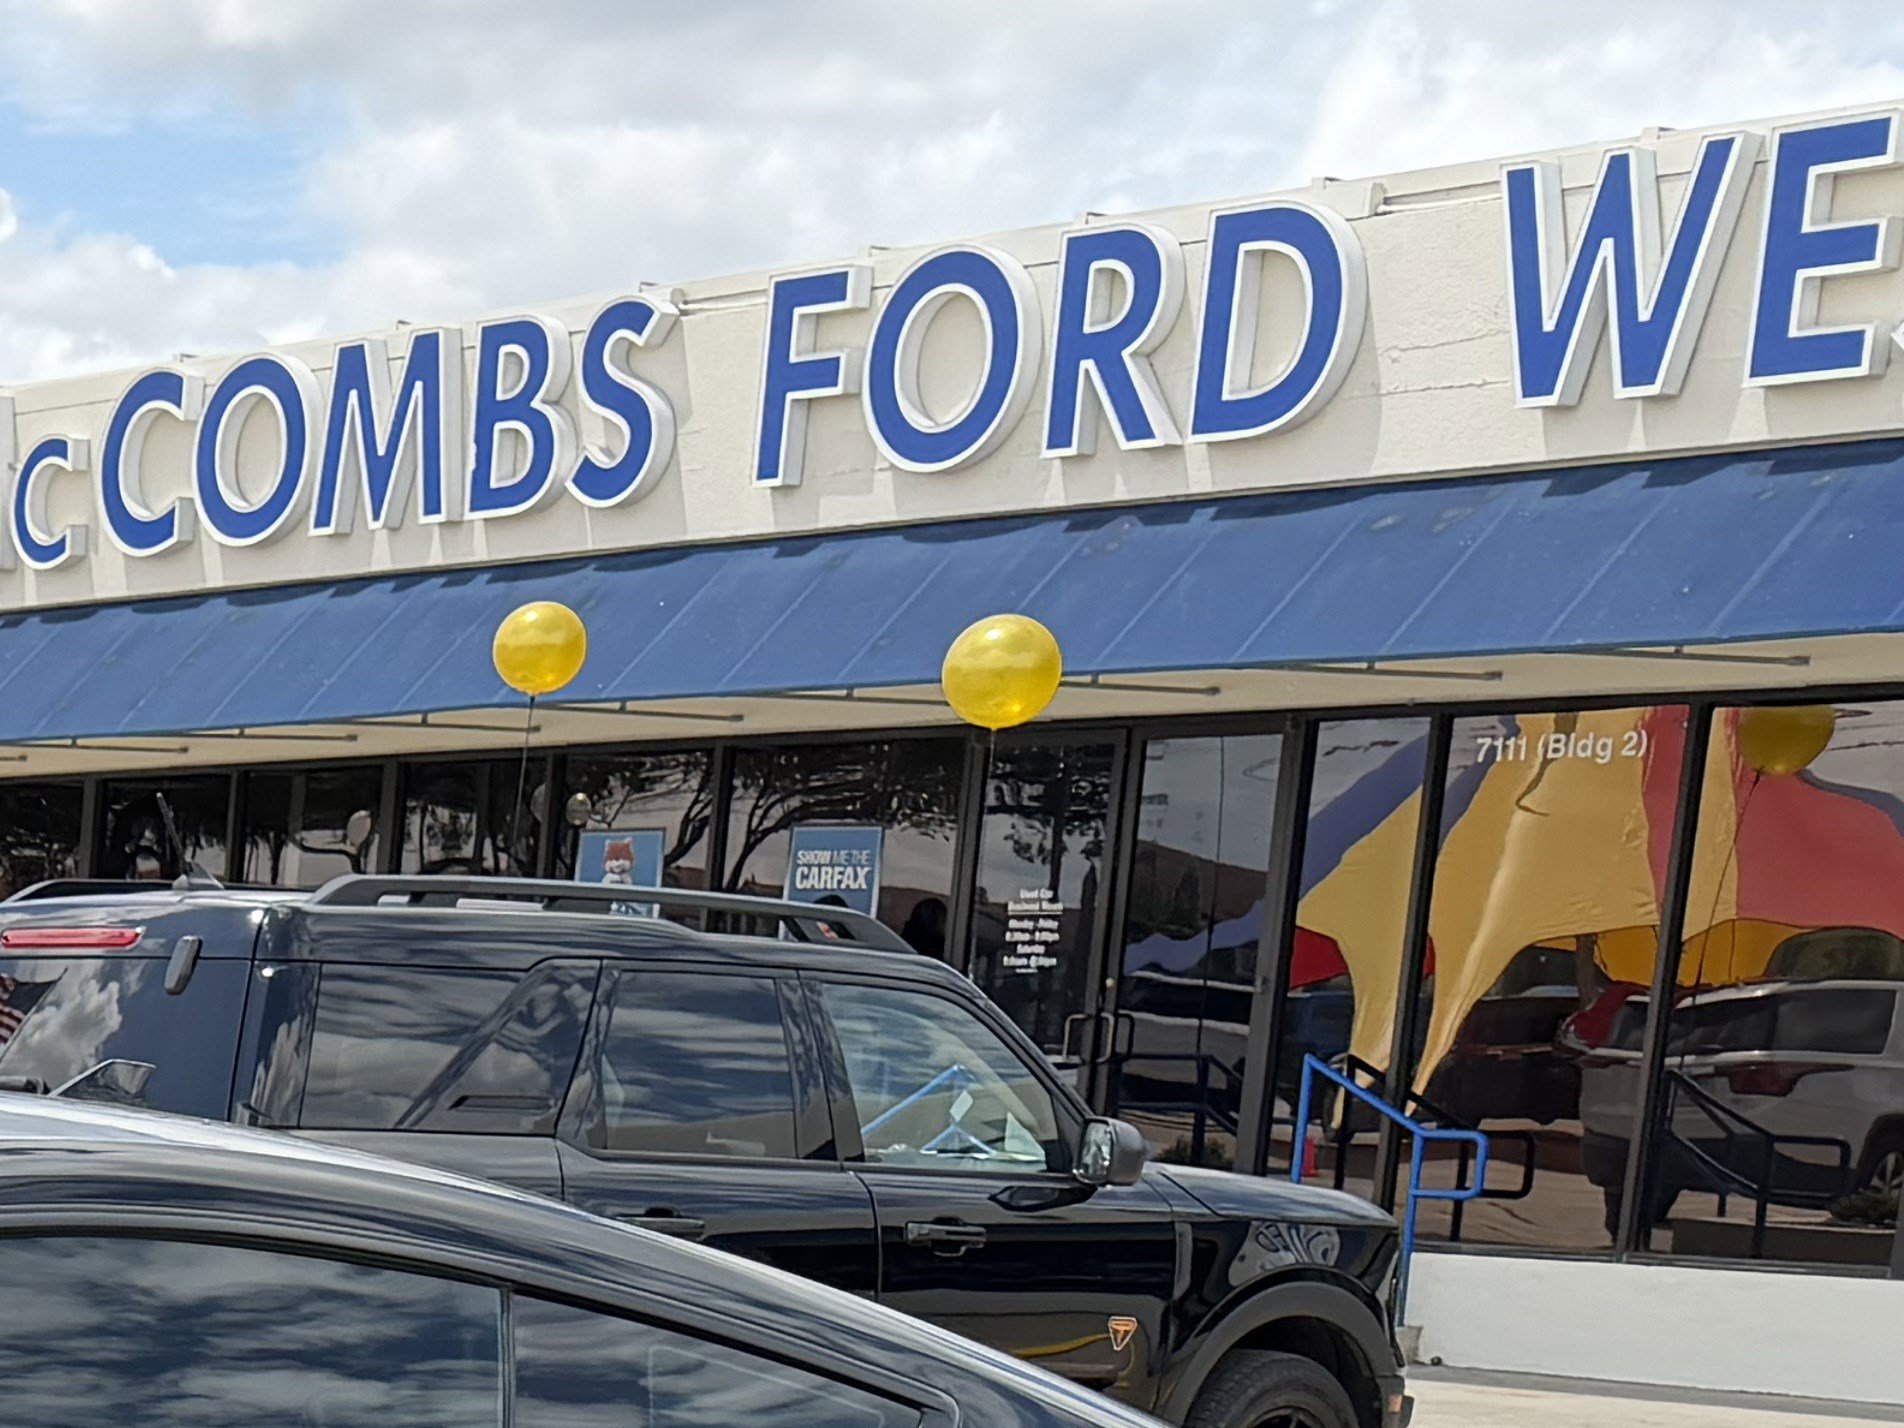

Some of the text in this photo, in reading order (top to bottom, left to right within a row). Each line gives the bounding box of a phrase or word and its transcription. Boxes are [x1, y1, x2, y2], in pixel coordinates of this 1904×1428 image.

[752, 199, 1365, 489] FORD
[1499, 107, 1904, 408] WE
[1476, 729, 1649, 765] 7111 (Bldg 2)
[796, 849, 831, 866] SHOW
[795, 865, 872, 890] CARFAX
